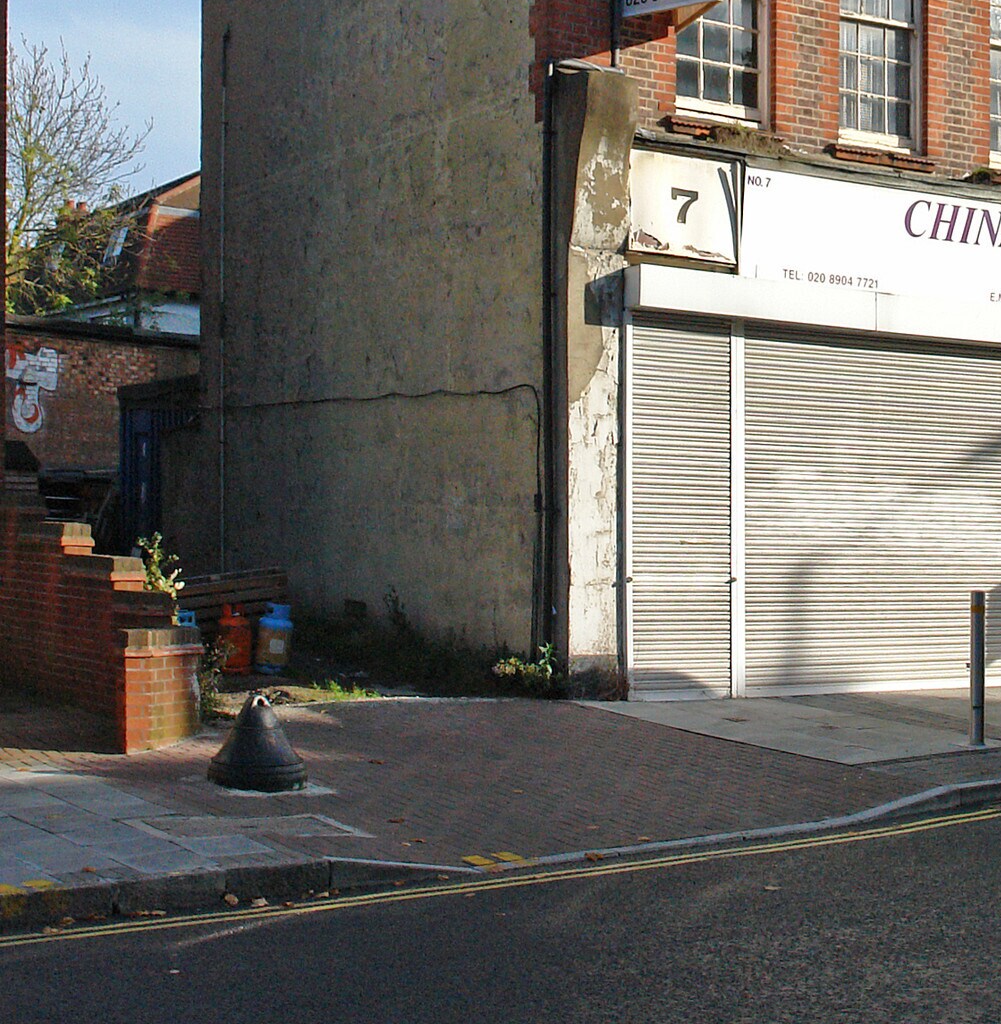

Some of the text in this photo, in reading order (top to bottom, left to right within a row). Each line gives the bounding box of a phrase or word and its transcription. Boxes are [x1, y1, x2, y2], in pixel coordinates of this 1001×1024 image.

[747, 176, 772, 188] NO. 7
[671, 187, 698, 224] 7
[783, 269, 879, 289] TEL: 020 8904 7721
